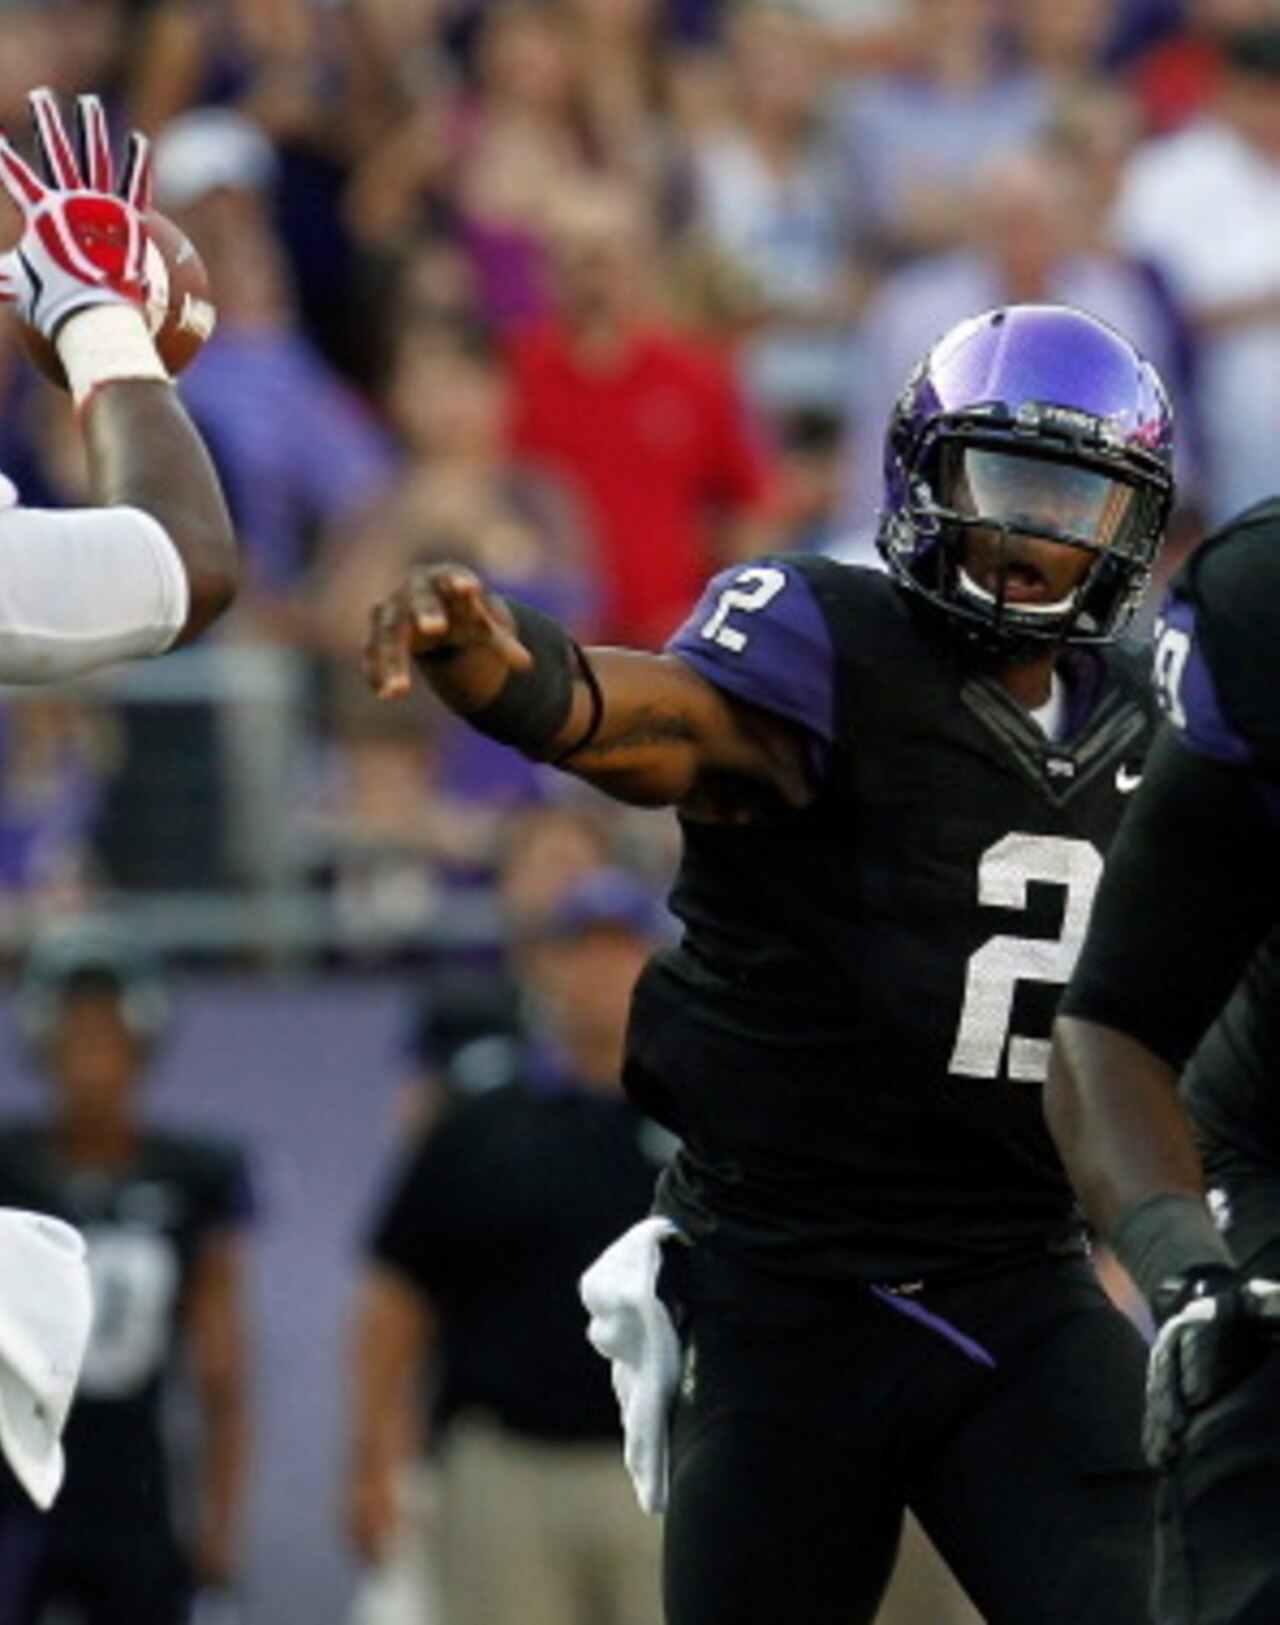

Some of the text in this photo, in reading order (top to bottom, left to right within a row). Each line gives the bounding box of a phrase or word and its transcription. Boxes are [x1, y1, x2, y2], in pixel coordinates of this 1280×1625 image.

[700, 567, 786, 653] 2
[1153, 617, 1187, 729] 9
[948, 831, 1104, 1082] 2
